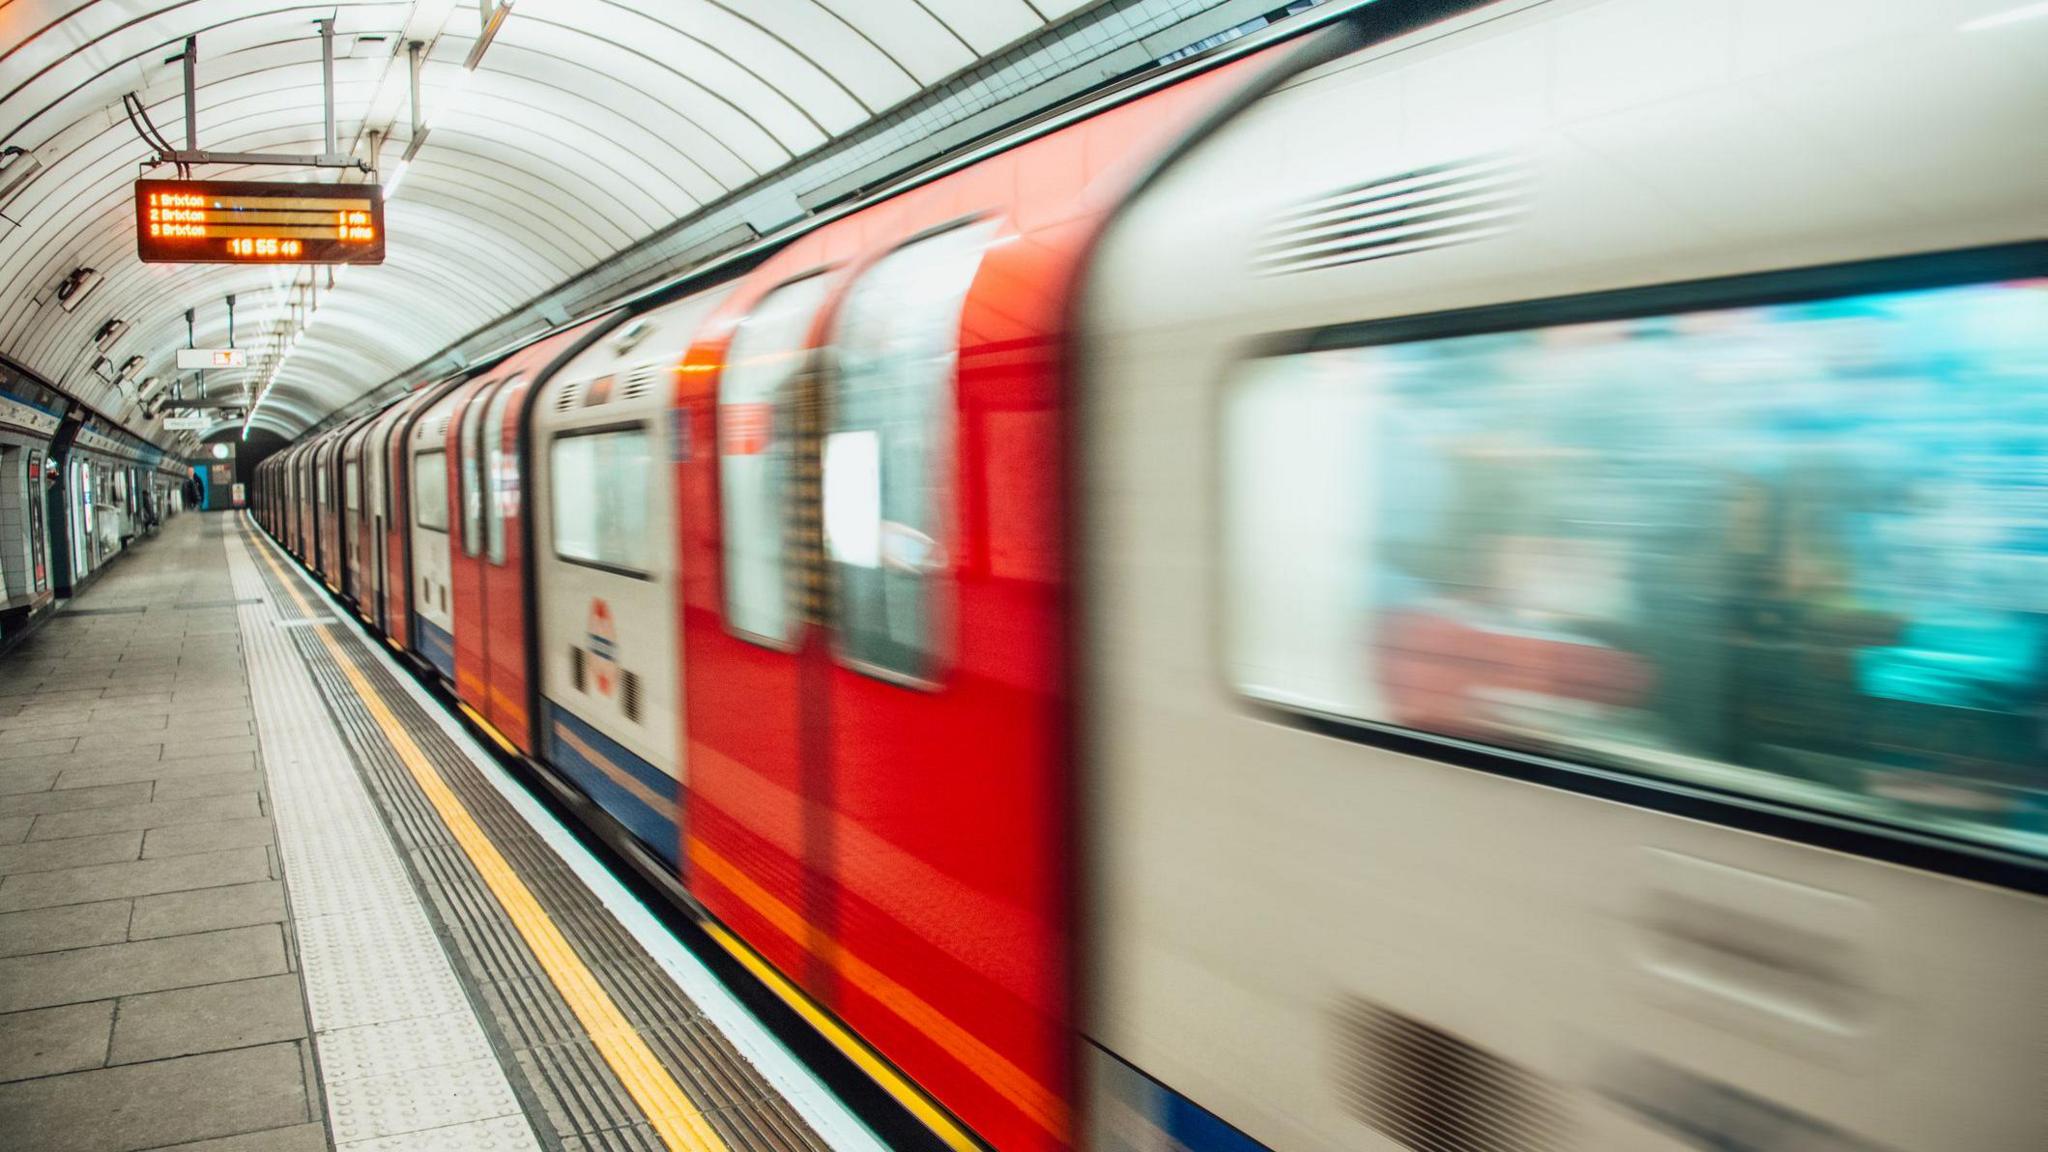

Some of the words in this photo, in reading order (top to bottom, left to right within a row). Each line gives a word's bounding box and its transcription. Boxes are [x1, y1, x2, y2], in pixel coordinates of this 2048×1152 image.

[150, 193, 157, 207] 1
[161, 193, 204, 208] Brixton
[150, 208, 158, 221] 2
[162, 208, 205, 222] Brixton
[150, 223, 159, 237] 3
[162, 223, 205, 237] Brixton
[348, 225, 372, 239] mins
